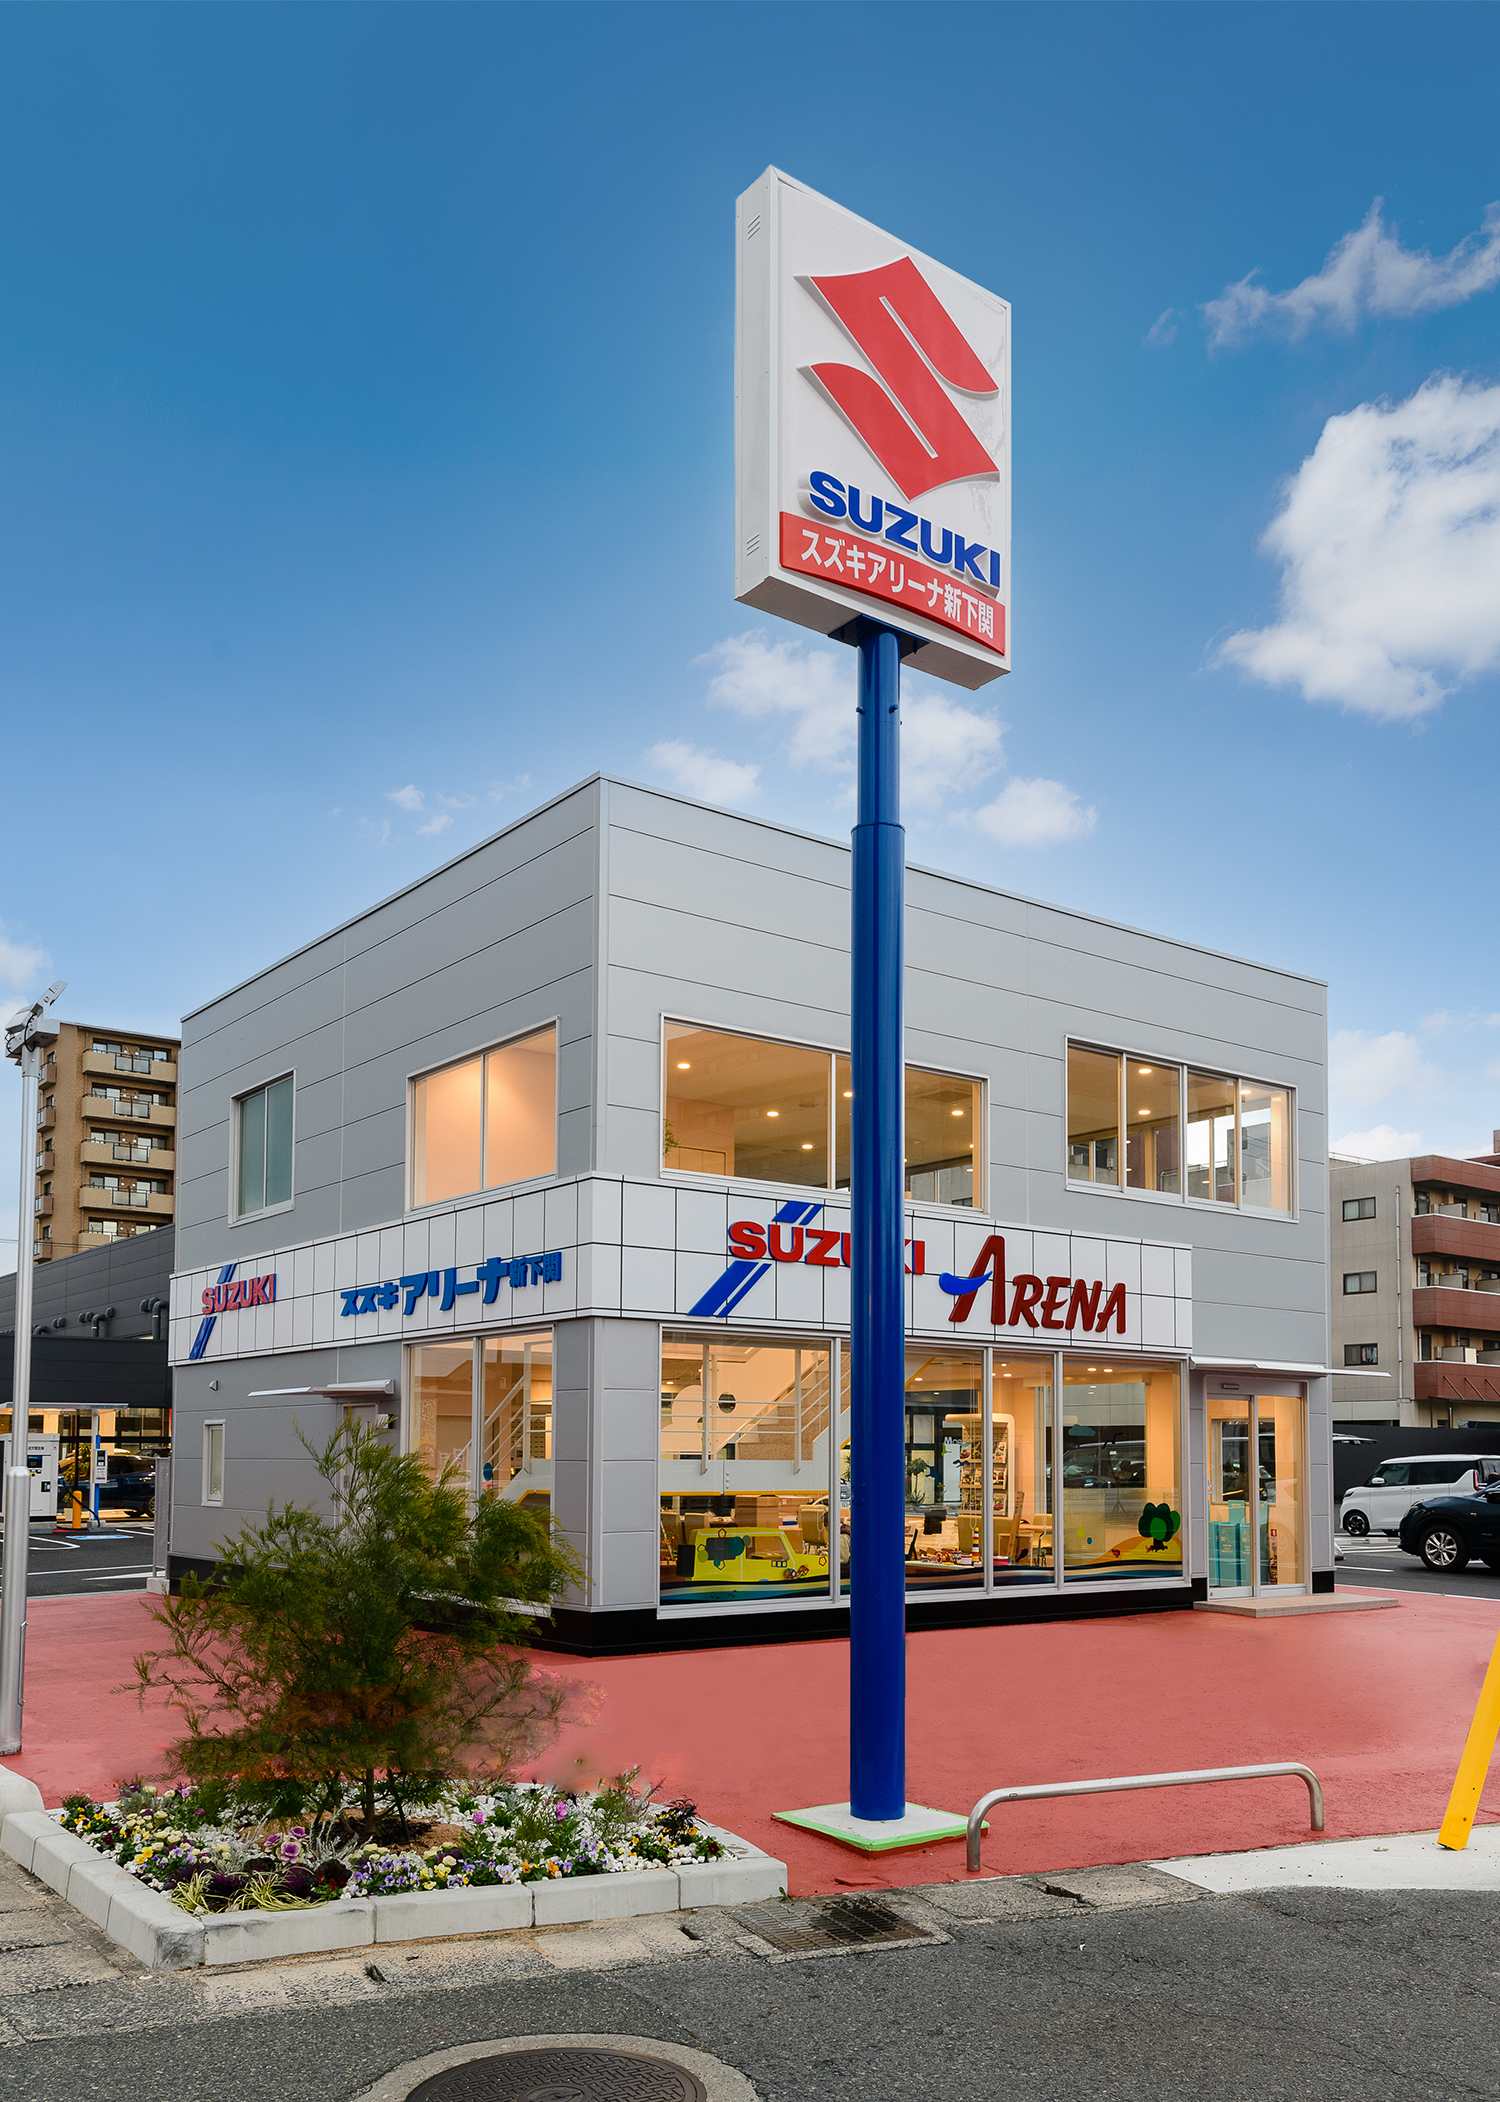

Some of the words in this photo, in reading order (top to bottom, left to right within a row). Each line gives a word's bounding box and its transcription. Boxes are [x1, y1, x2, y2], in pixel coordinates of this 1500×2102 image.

[809, 470, 1000, 589] SUZUKI
[800, 528, 994, 639] スズキアリーナ新下関
[340, 1251, 562, 1316] スズキアリーナ新下関
[728, 1220, 926, 1275] SUZI
[947, 1234, 1126, 1334] ARENA
[201, 1273, 277, 1316] SUZUKI
